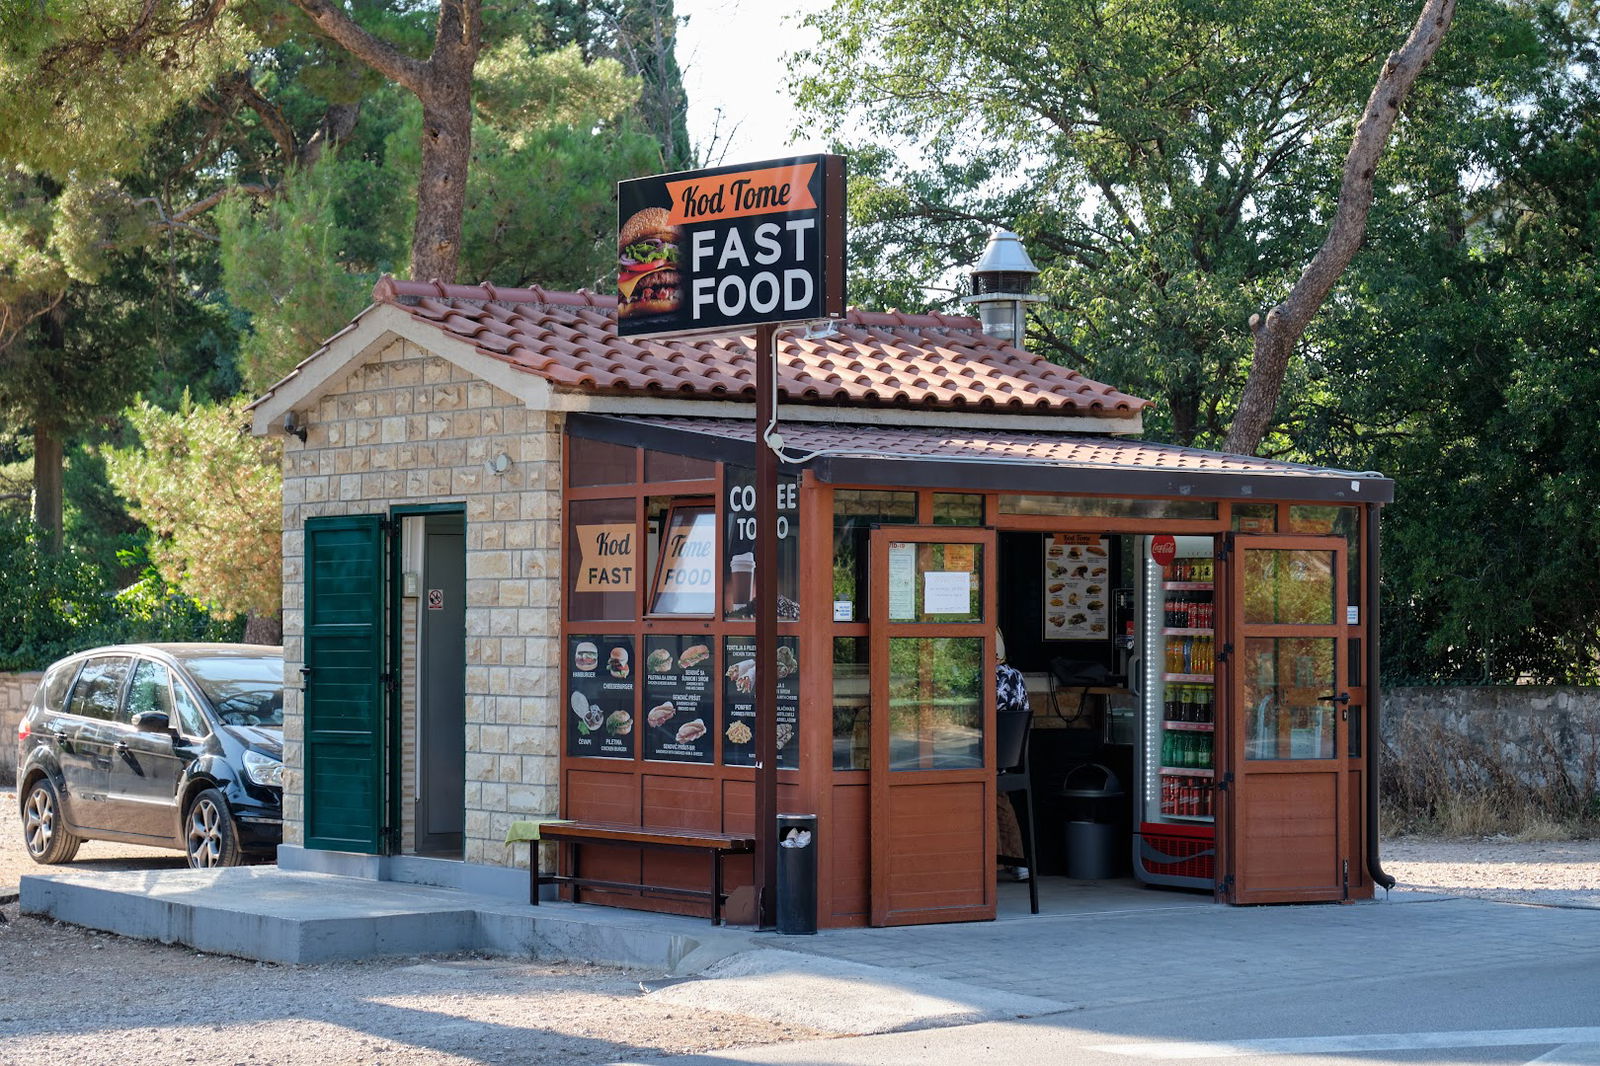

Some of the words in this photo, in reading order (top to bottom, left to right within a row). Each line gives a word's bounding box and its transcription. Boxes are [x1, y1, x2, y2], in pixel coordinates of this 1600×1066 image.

[682, 184, 725, 218] Kod
[730, 179, 791, 211] Tome
[692, 218, 815, 273] FAST
[692, 268, 814, 320] FOOD
[729, 484, 797, 512] COEE
[737, 517, 757, 540] TO
[596, 531, 632, 556] Kod
[671, 534, 712, 558] Tome
[588, 567, 633, 585] FAST
[664, 568, 712, 586] FOOD
